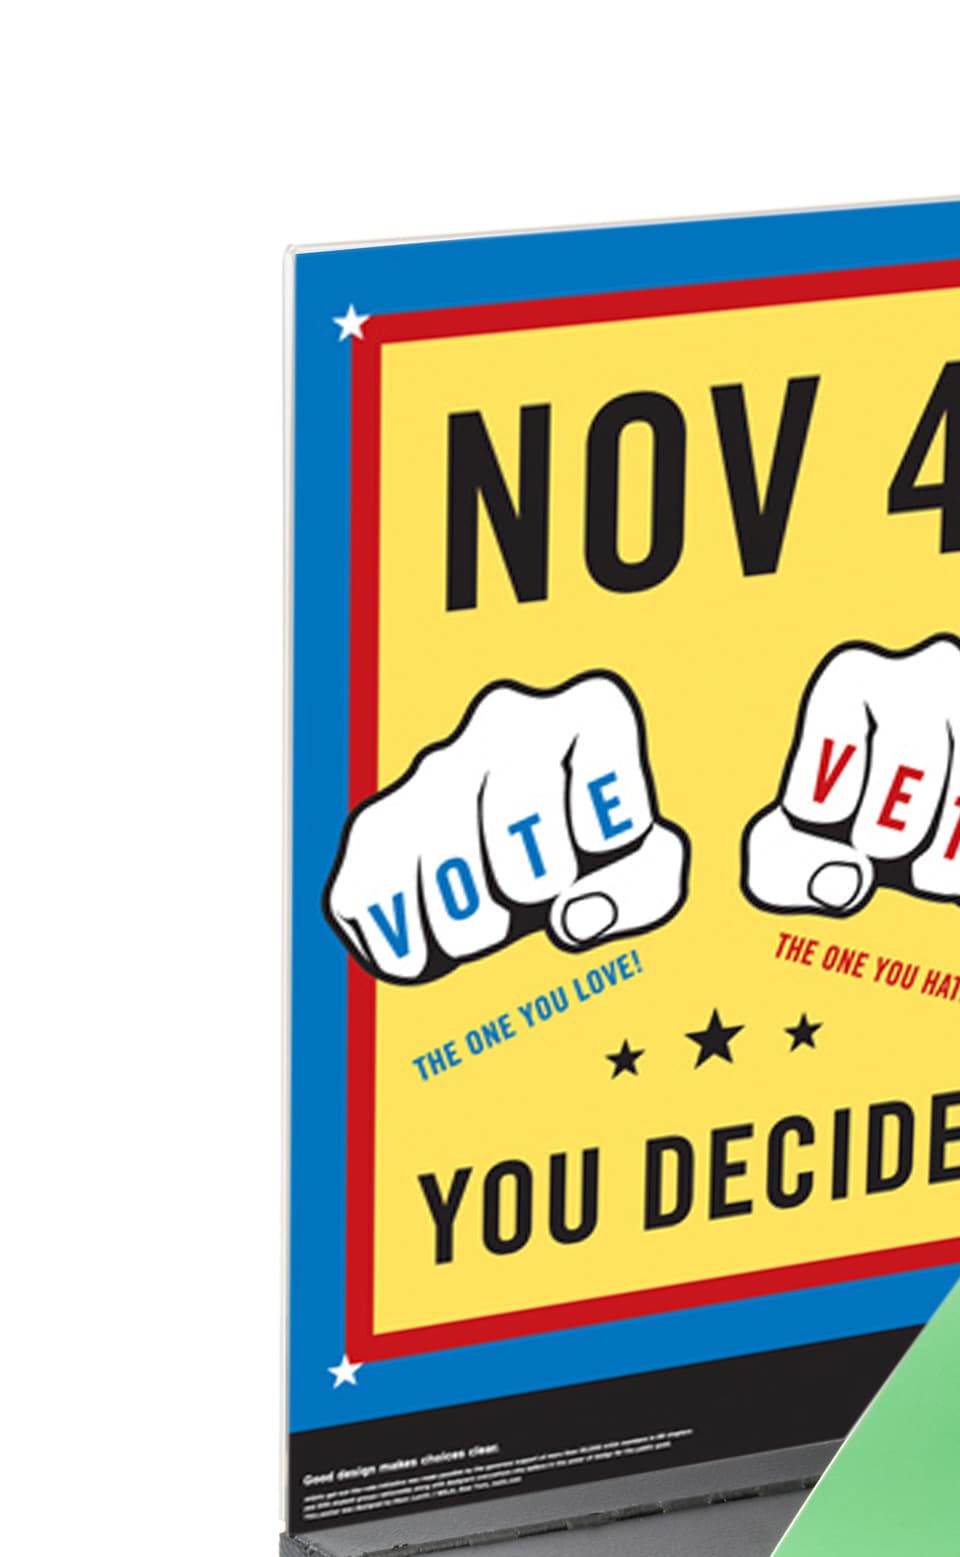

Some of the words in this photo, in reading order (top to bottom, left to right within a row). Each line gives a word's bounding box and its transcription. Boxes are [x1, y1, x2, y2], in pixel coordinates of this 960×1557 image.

[445, 375, 821, 613] NOV
[369, 771, 634, 960] VOTE
[411, 1040, 463, 1082] THE
[465, 1013, 517, 1056] ONE
[517, 986, 570, 1029] YOU
[572, 949, 644, 1003] LOVE!
[775, 932, 820, 967] THE
[821, 944, 870, 979] ONE
[873, 956, 920, 991] YOU
[417, 1146, 600, 1265] YOU
[302, 1471, 335, 1487] Good
[336, 1465, 377, 1479] design
[378, 1457, 419, 1473] makes
[420, 1449, 466, 1467] choices
